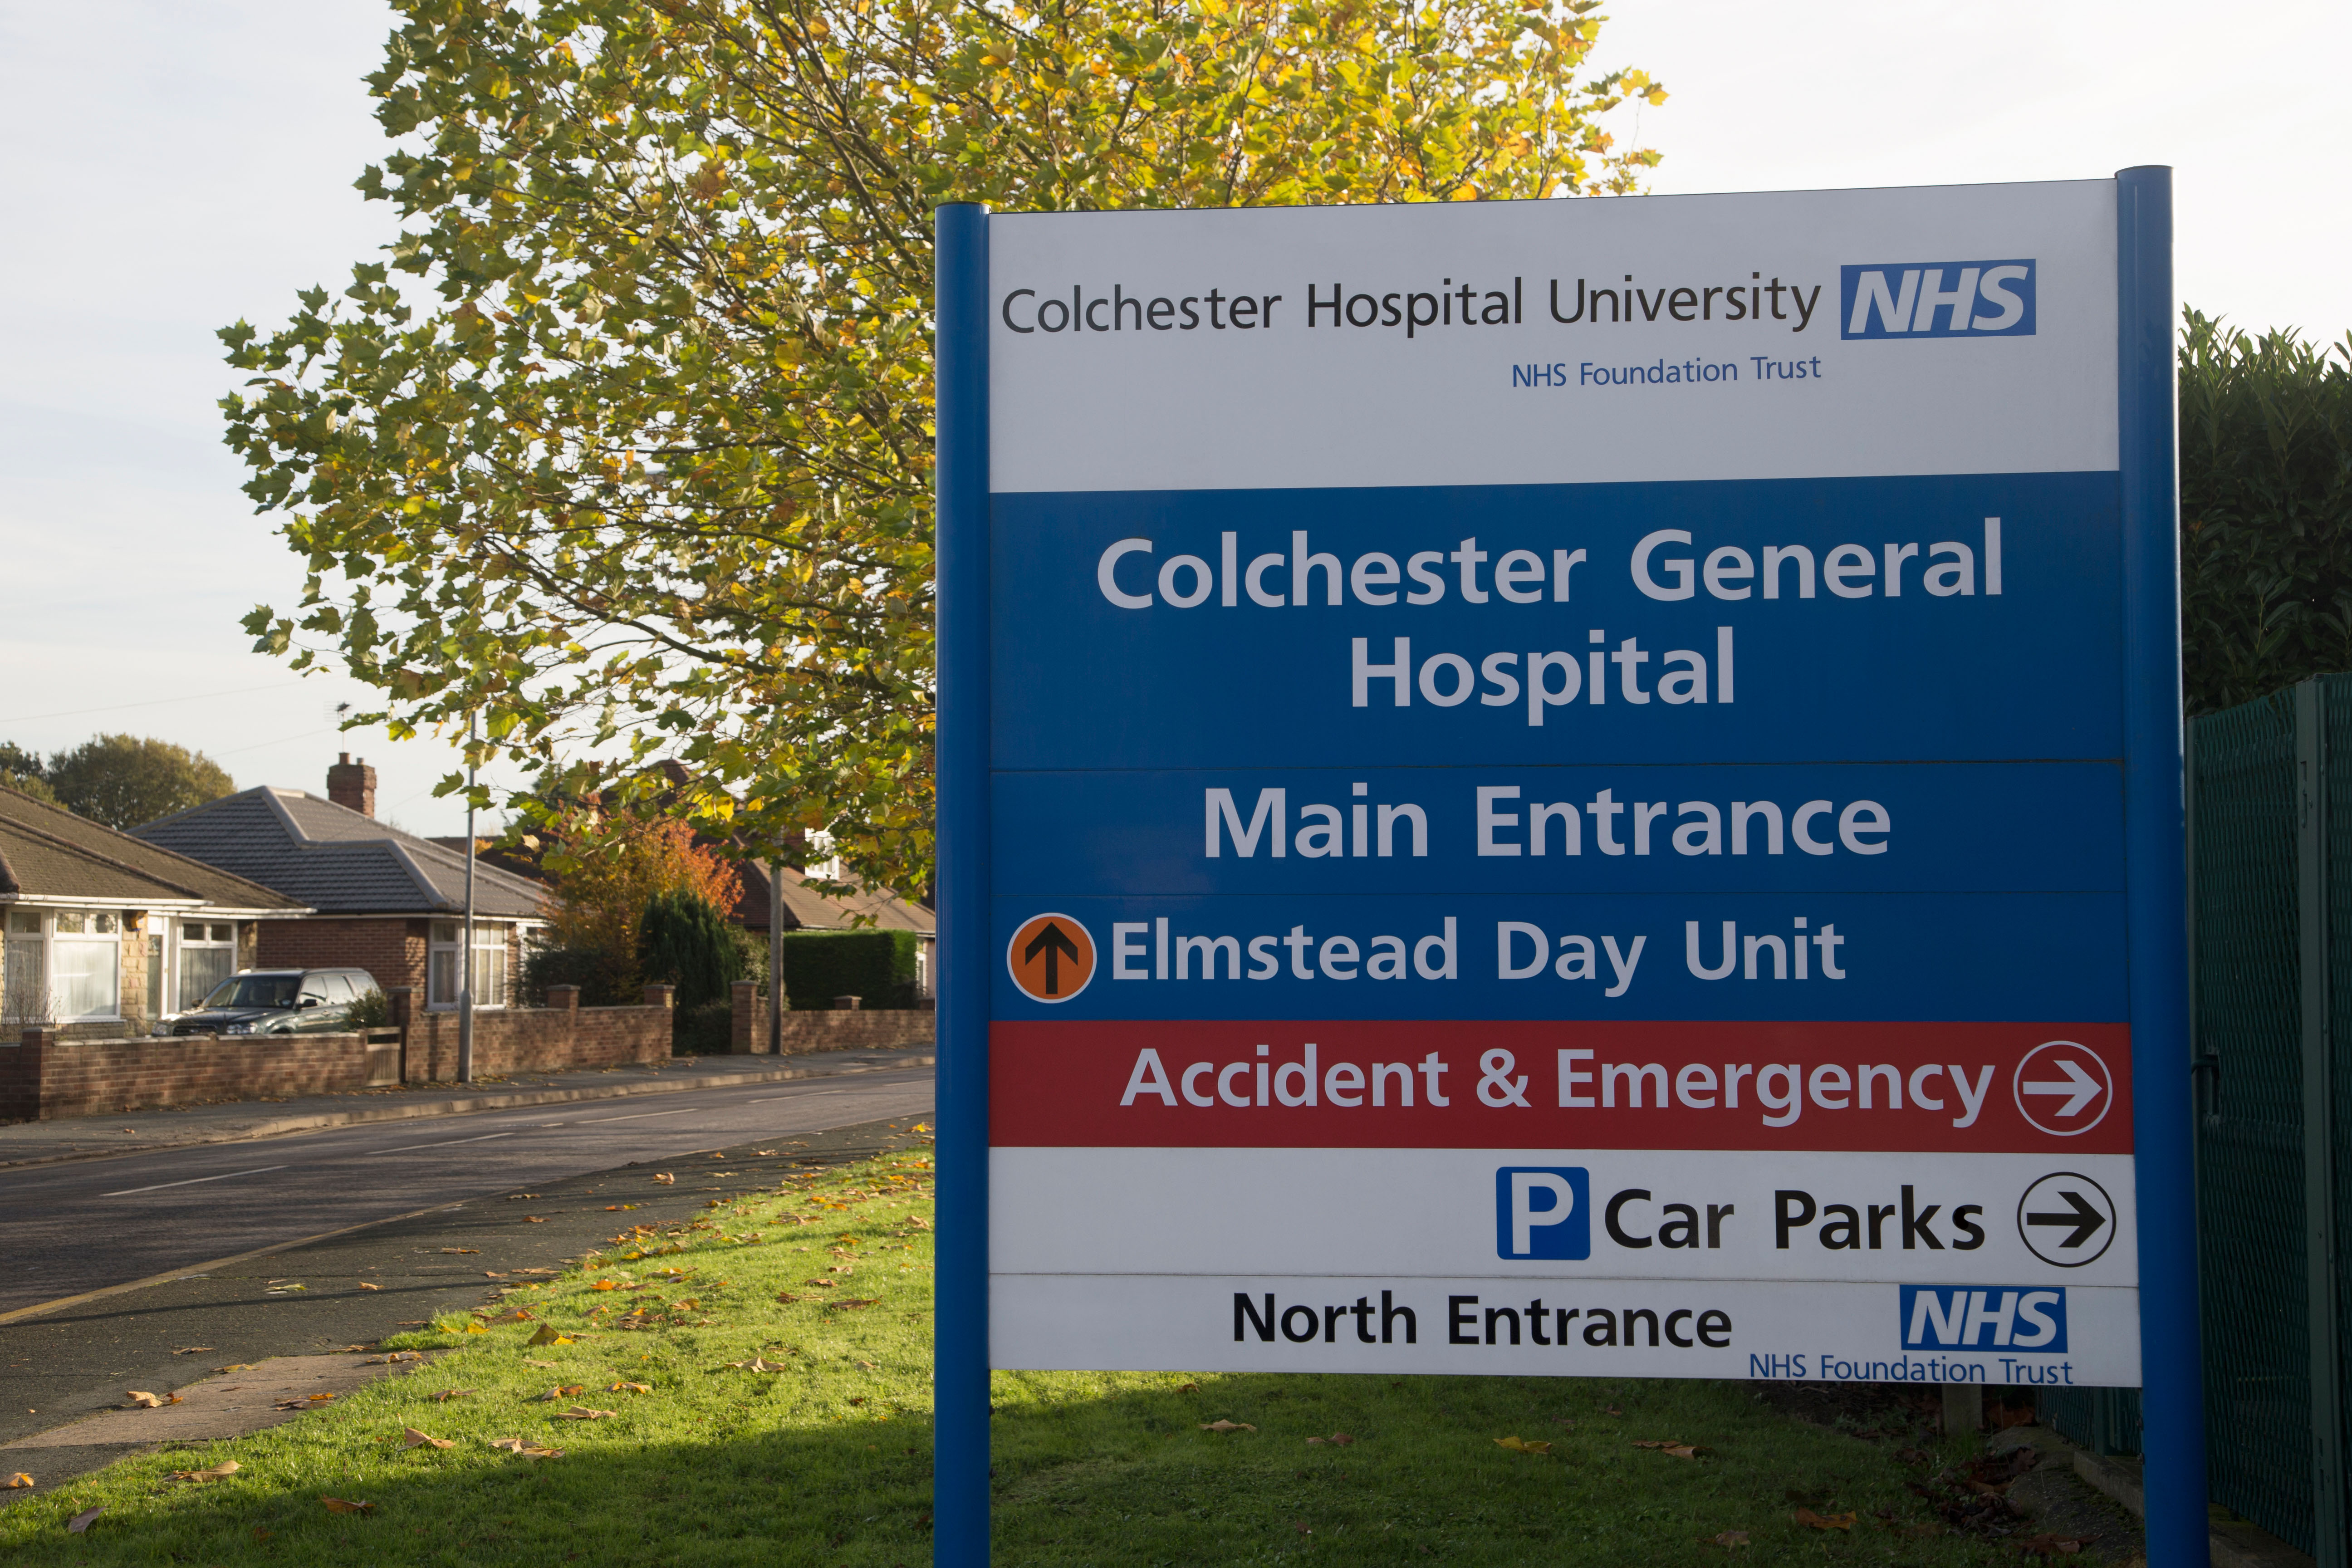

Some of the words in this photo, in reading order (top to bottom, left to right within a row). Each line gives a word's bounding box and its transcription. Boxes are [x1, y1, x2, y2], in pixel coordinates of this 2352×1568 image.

[1003, 284, 1282, 333] Colchester
[1308, 277, 1521, 338] Hospital
[1551, 272, 1821, 332] University
[1848, 265, 2029, 333] NHS
[1513, 363, 1566, 387] NHS
[1581, 359, 1737, 385] Foundation
[1750, 356, 1821, 379] Trust
[1098, 530, 1586, 609] Colchester
[1631, 517, 2001, 601] General
[1352, 627, 1733, 726] Hospital
[1206, 783, 1427, 858] Main
[1477, 786, 1890, 856] Entrance
[1113, 916, 1457, 980] Elmstead
[1498, 921, 1646, 997] Day
[1686, 917, 1845, 980] Unit
[1120, 1044, 1449, 1107] Accident
[1477, 1049, 1531, 1107] &
[1558, 1049, 1995, 1127] Emergency
[1511, 1172, 1574, 1254] P
[1605, 1189, 1734, 1248] Car
[1775, 1185, 1984, 1250] Parks
[1234, 1290, 1416, 1343] North
[1449, 1295, 1731, 1348] Entrance
[1907, 1290, 2060, 1347] NHS
[1749, 1353, 1807, 1378] NHS
[1821, 1355, 1985, 1382] Foundation
[1998, 1358, 2073, 1385] Trust
